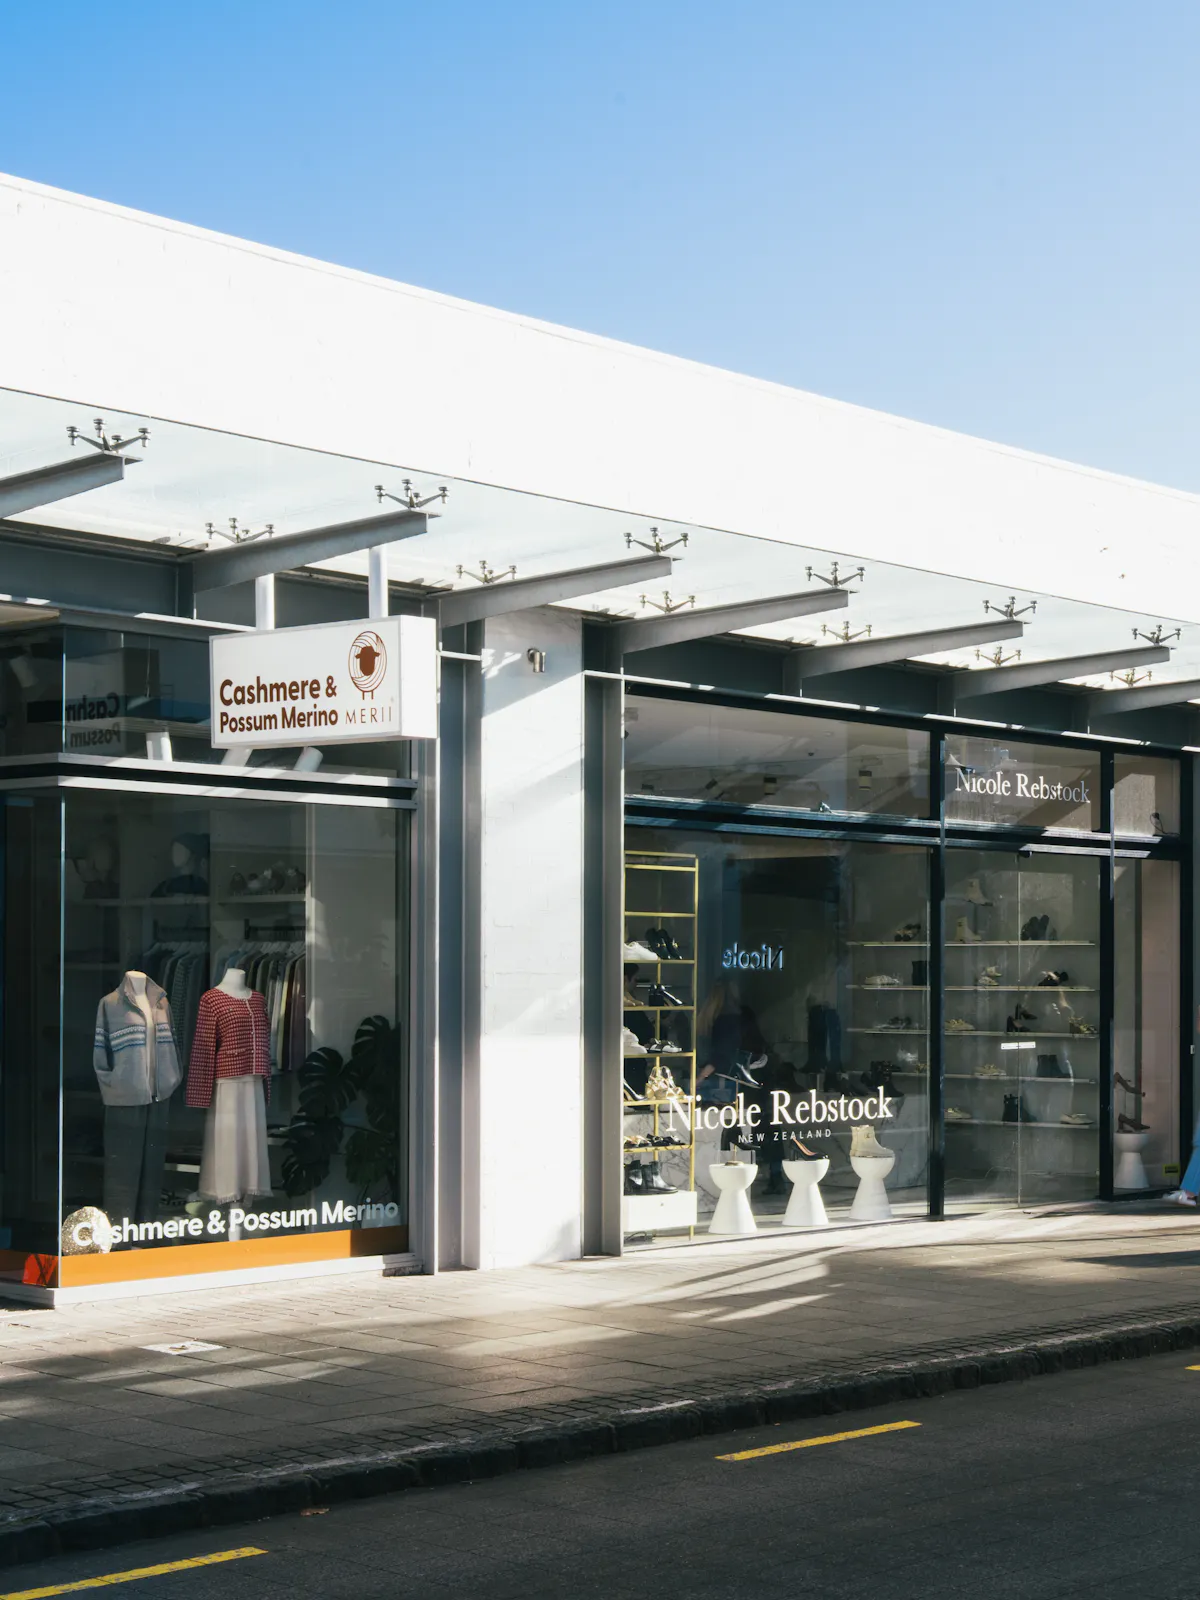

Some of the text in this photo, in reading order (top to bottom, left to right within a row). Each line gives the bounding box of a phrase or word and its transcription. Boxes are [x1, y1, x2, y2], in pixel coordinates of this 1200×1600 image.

[219, 675, 337, 706] Cashmere &
[220, 703, 338, 733] Possum Merino
[345, 706, 392, 725] MERII
[955, 767, 1091, 803] Nicole Rebstock
[666, 1085, 893, 1132] Nicole Rebstock
[738, 1129, 832, 1143] NEW ZEALAND
[207, 1209, 226, 1235] &
[230, 1208, 317, 1232] Possum
[321, 1197, 399, 1225] Merino
